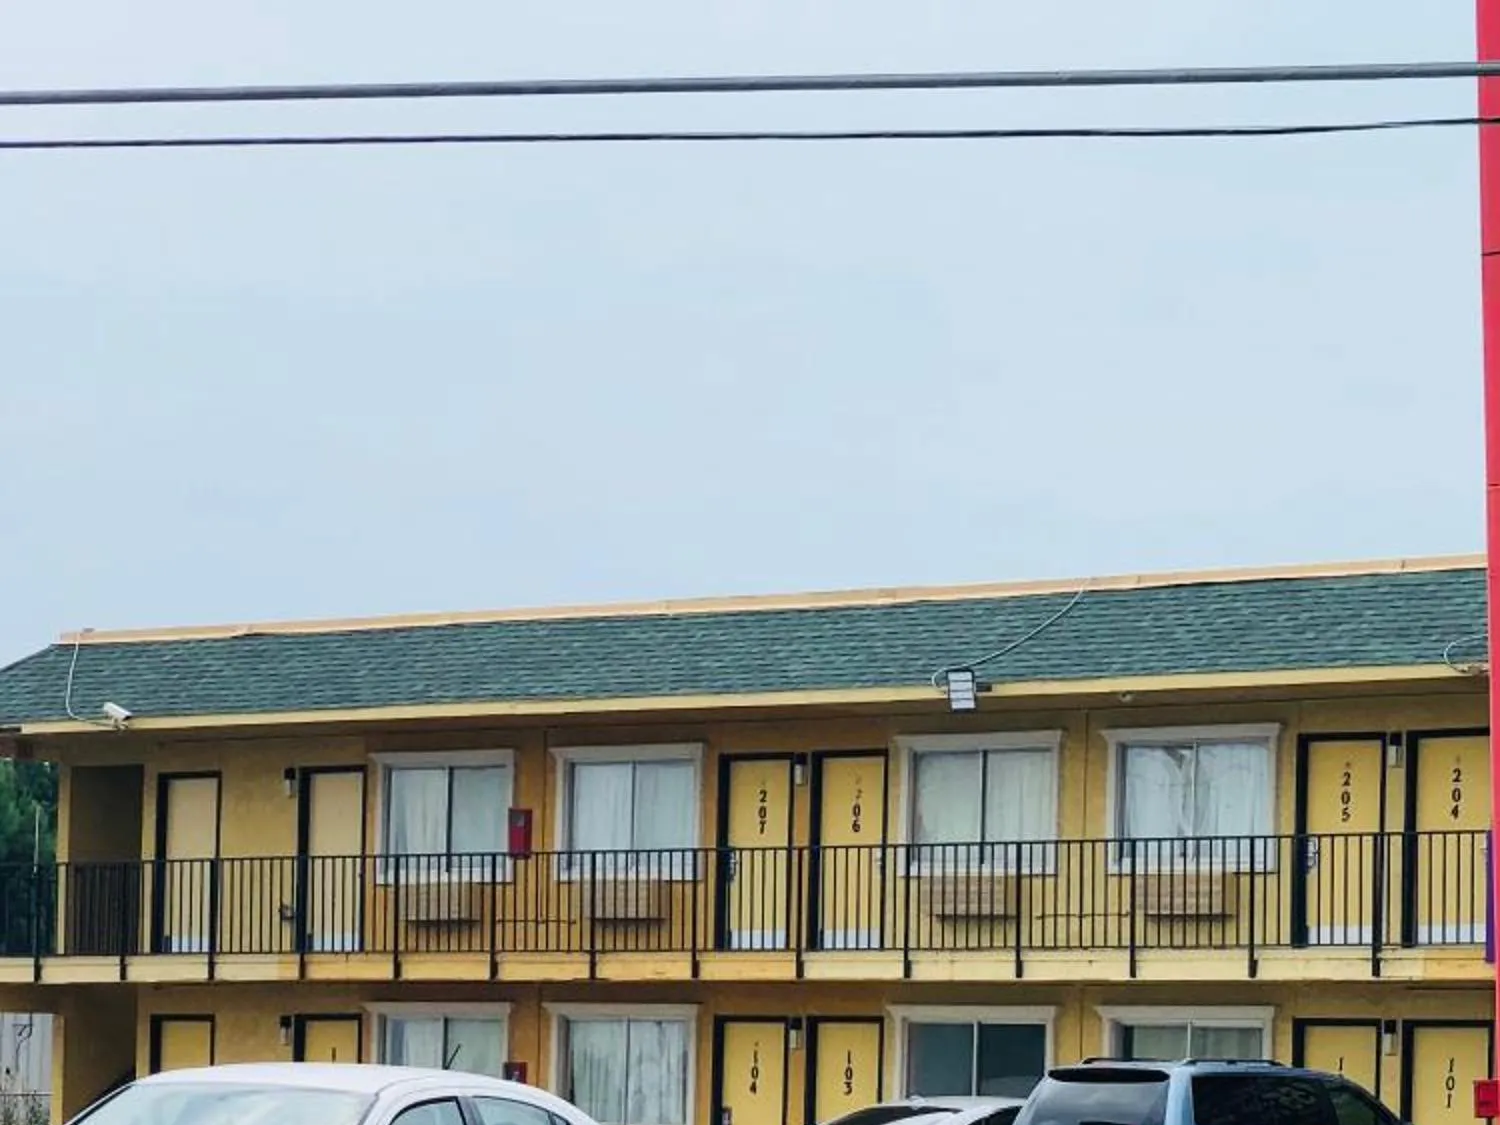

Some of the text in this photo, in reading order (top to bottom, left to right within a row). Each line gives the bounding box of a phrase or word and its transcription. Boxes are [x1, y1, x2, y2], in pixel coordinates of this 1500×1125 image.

[758, 789, 768, 835] 207
[1341, 771, 1351, 822] 205
[1451, 768, 1461, 820] 204
[844, 1050, 853, 1096] 103
[1446, 1057, 1455, 1108] 101
